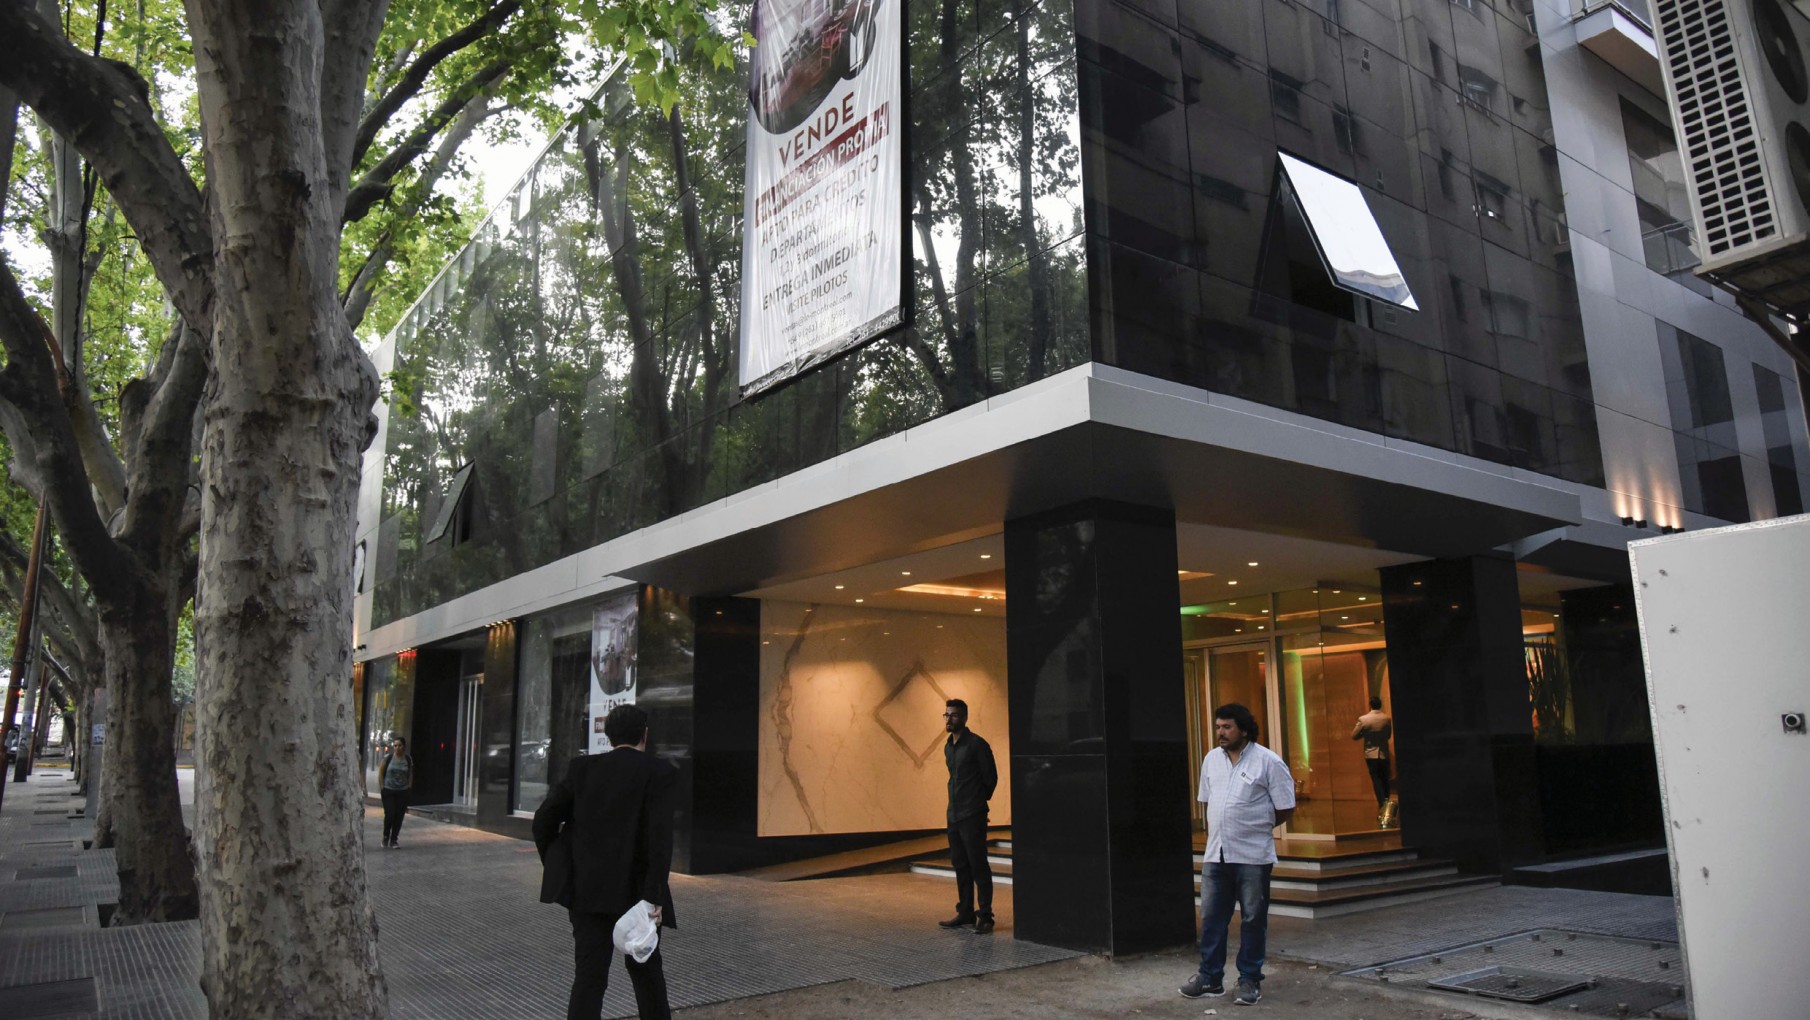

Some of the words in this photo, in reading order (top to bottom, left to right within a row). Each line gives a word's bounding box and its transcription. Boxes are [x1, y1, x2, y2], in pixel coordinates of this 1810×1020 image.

[779, 92, 855, 167] VENDE
[761, 213, 789, 247] APTO
[790, 193, 820, 223] PARA
[762, 271, 808, 310] ENTREGA
[811, 230, 878, 280] INMEDIATA
[786, 290, 809, 316] VISITE
[810, 270, 848, 302] PILOTOS
